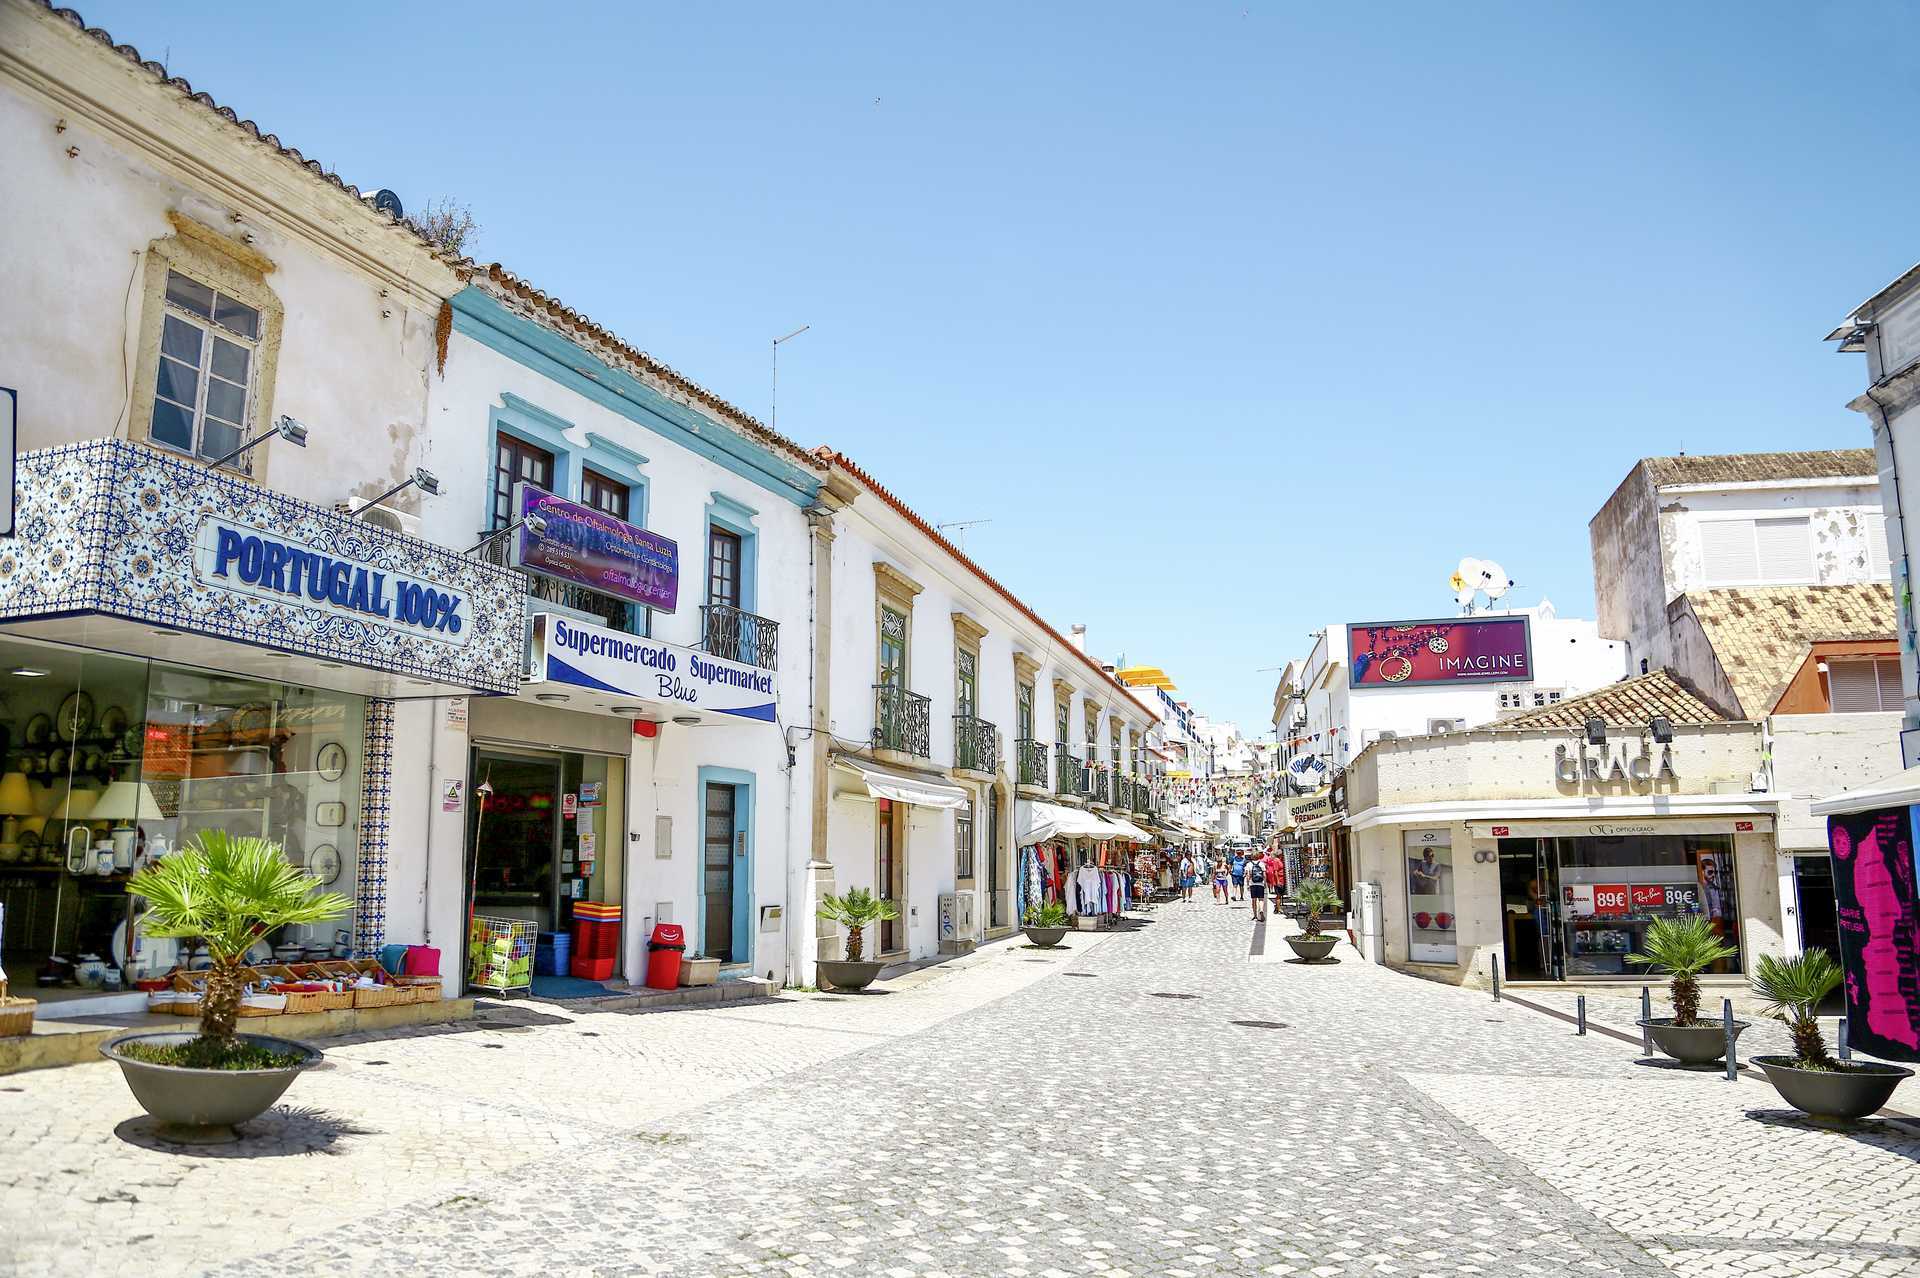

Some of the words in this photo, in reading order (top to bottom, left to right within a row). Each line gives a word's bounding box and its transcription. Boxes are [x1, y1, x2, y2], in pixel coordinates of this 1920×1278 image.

[214, 526, 391, 618] PORTUGAL
[395, 580, 462, 634] 100%
[555, 620, 676, 672] Supermercado
[690, 655, 772, 694] Supermarket
[1439, 654, 1524, 670] IMAGINE
[655, 674, 698, 703] Blue
[1558, 756, 1682, 785] GRAÇA
[1291, 799, 1327, 816] SOUVENIRS
[1633, 888, 1661, 903] Ray-Ban
